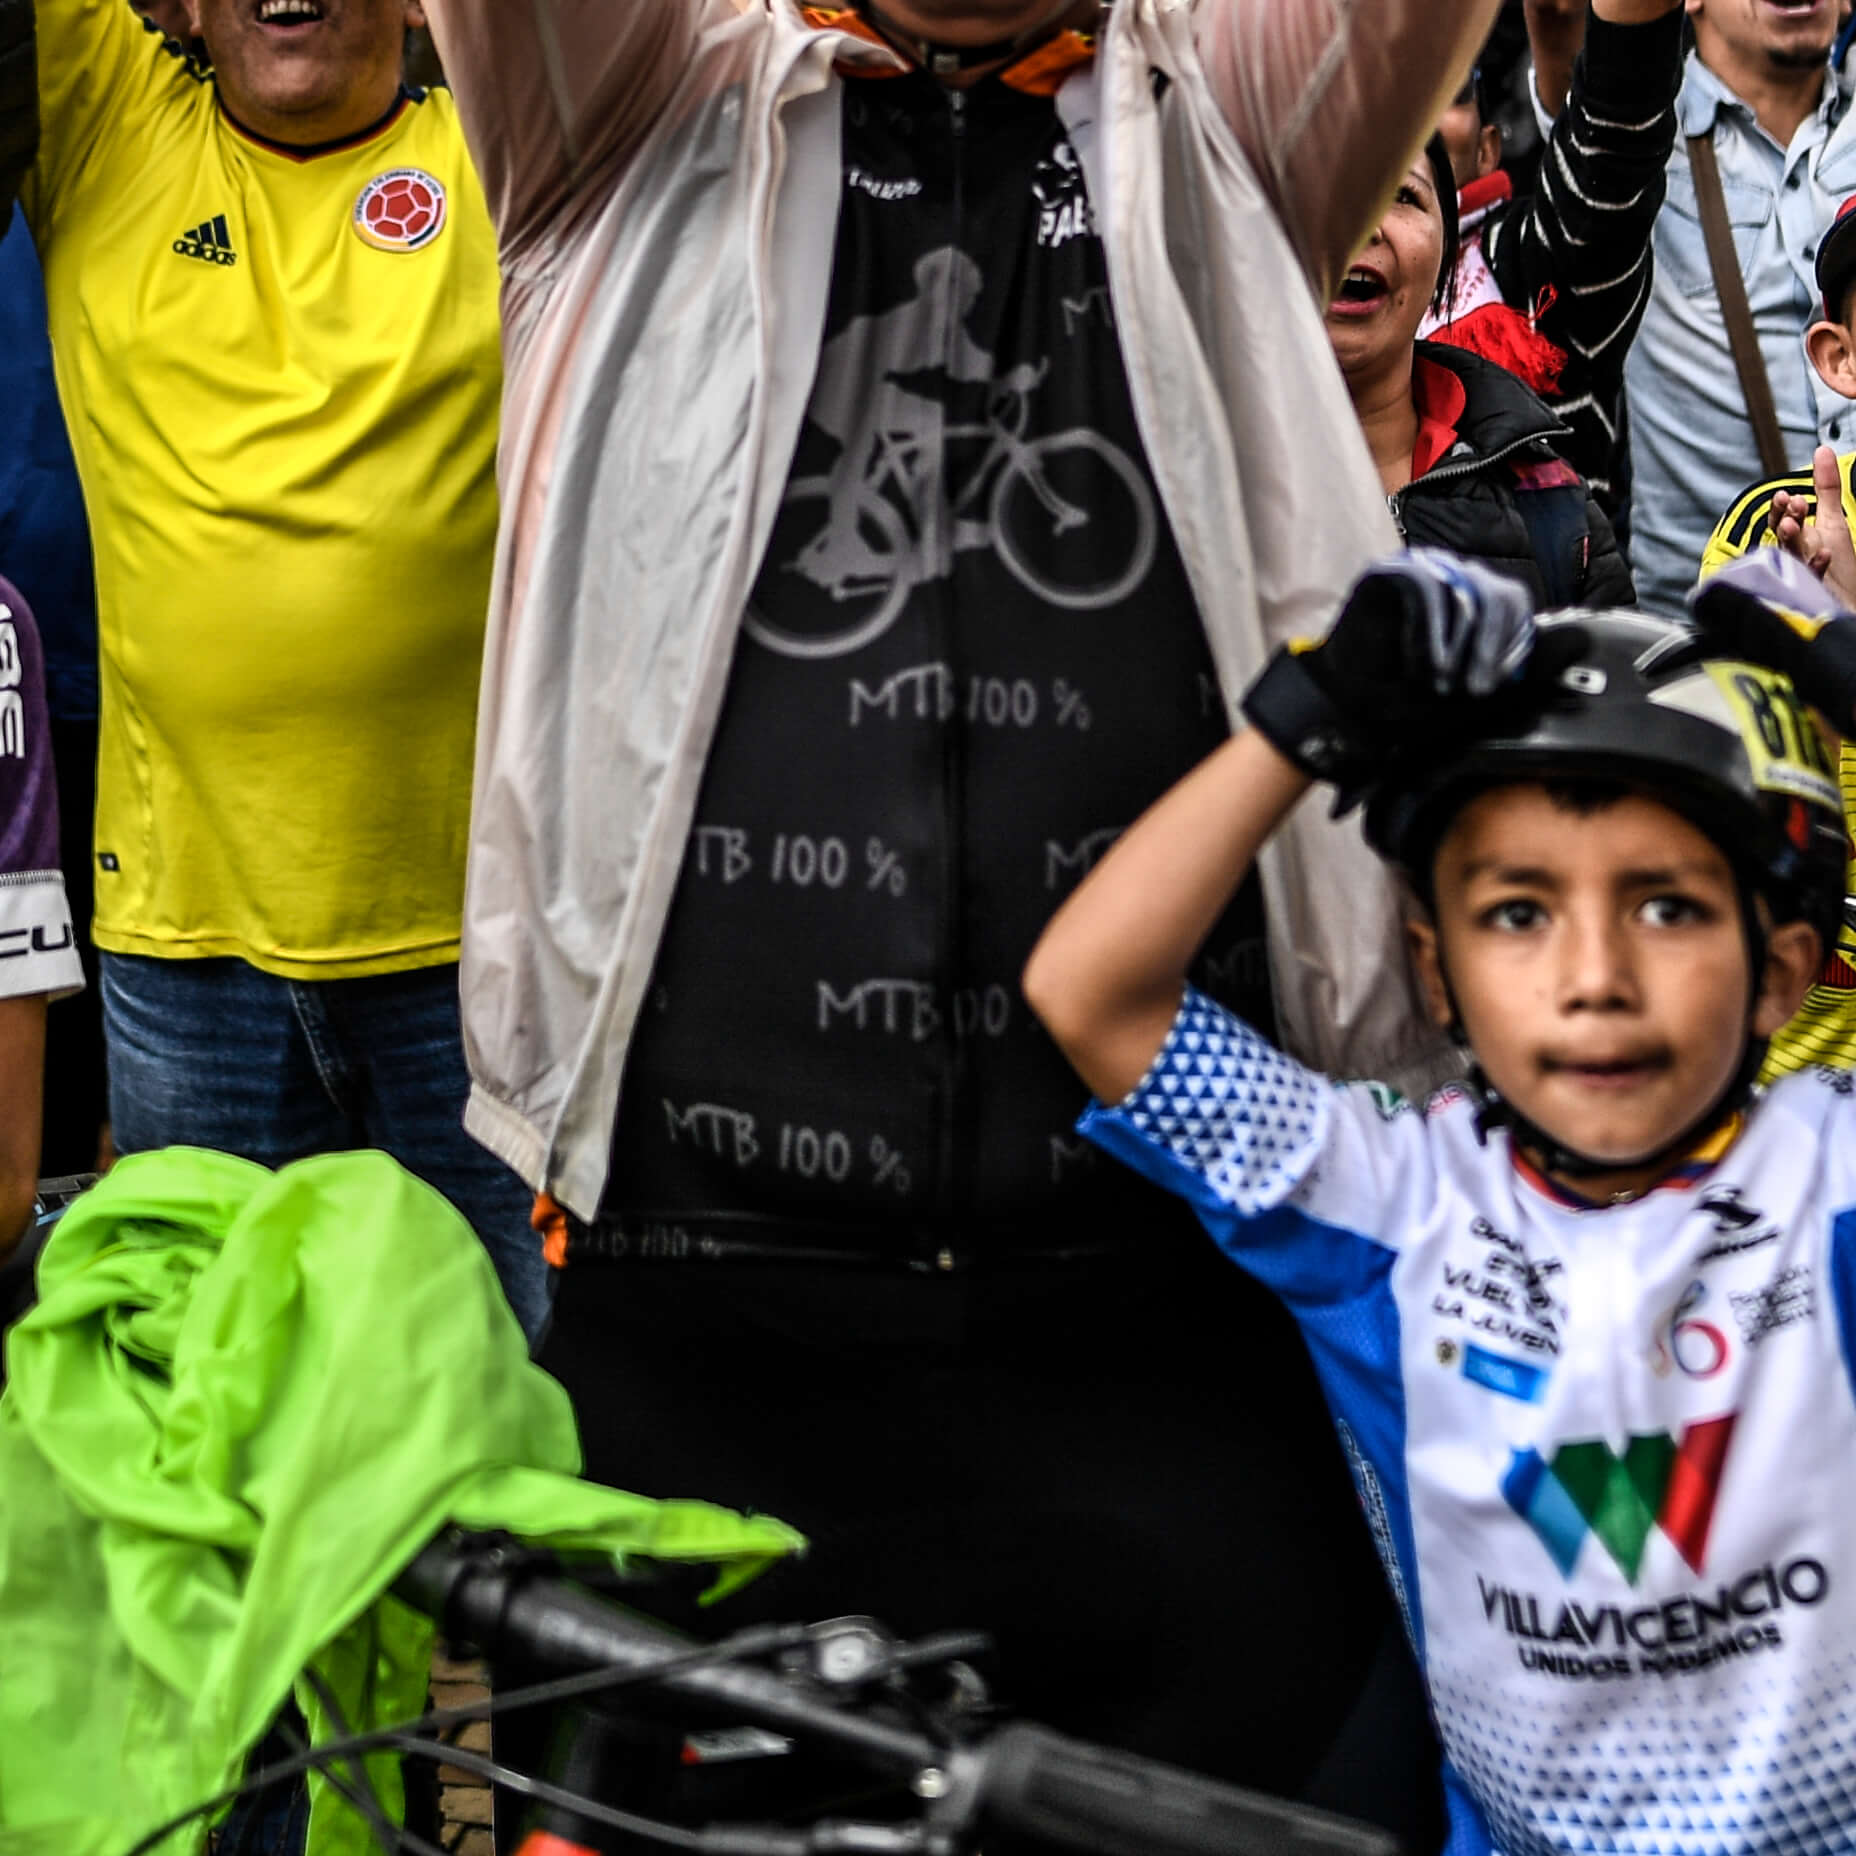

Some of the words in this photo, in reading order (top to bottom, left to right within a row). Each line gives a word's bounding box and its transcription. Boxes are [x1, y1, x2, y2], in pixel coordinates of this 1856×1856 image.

[172, 239, 237, 267] adidas
[967, 676, 1037, 727] 100
[695, 825, 751, 884] TB
[770, 835, 848, 887] 100
[662, 1097, 760, 1167] MTB
[778, 1123, 851, 1181] 100
[1475, 1555, 1831, 1651] VILLAVICENCIO
[1517, 1645, 1634, 1681] UNIDOS
